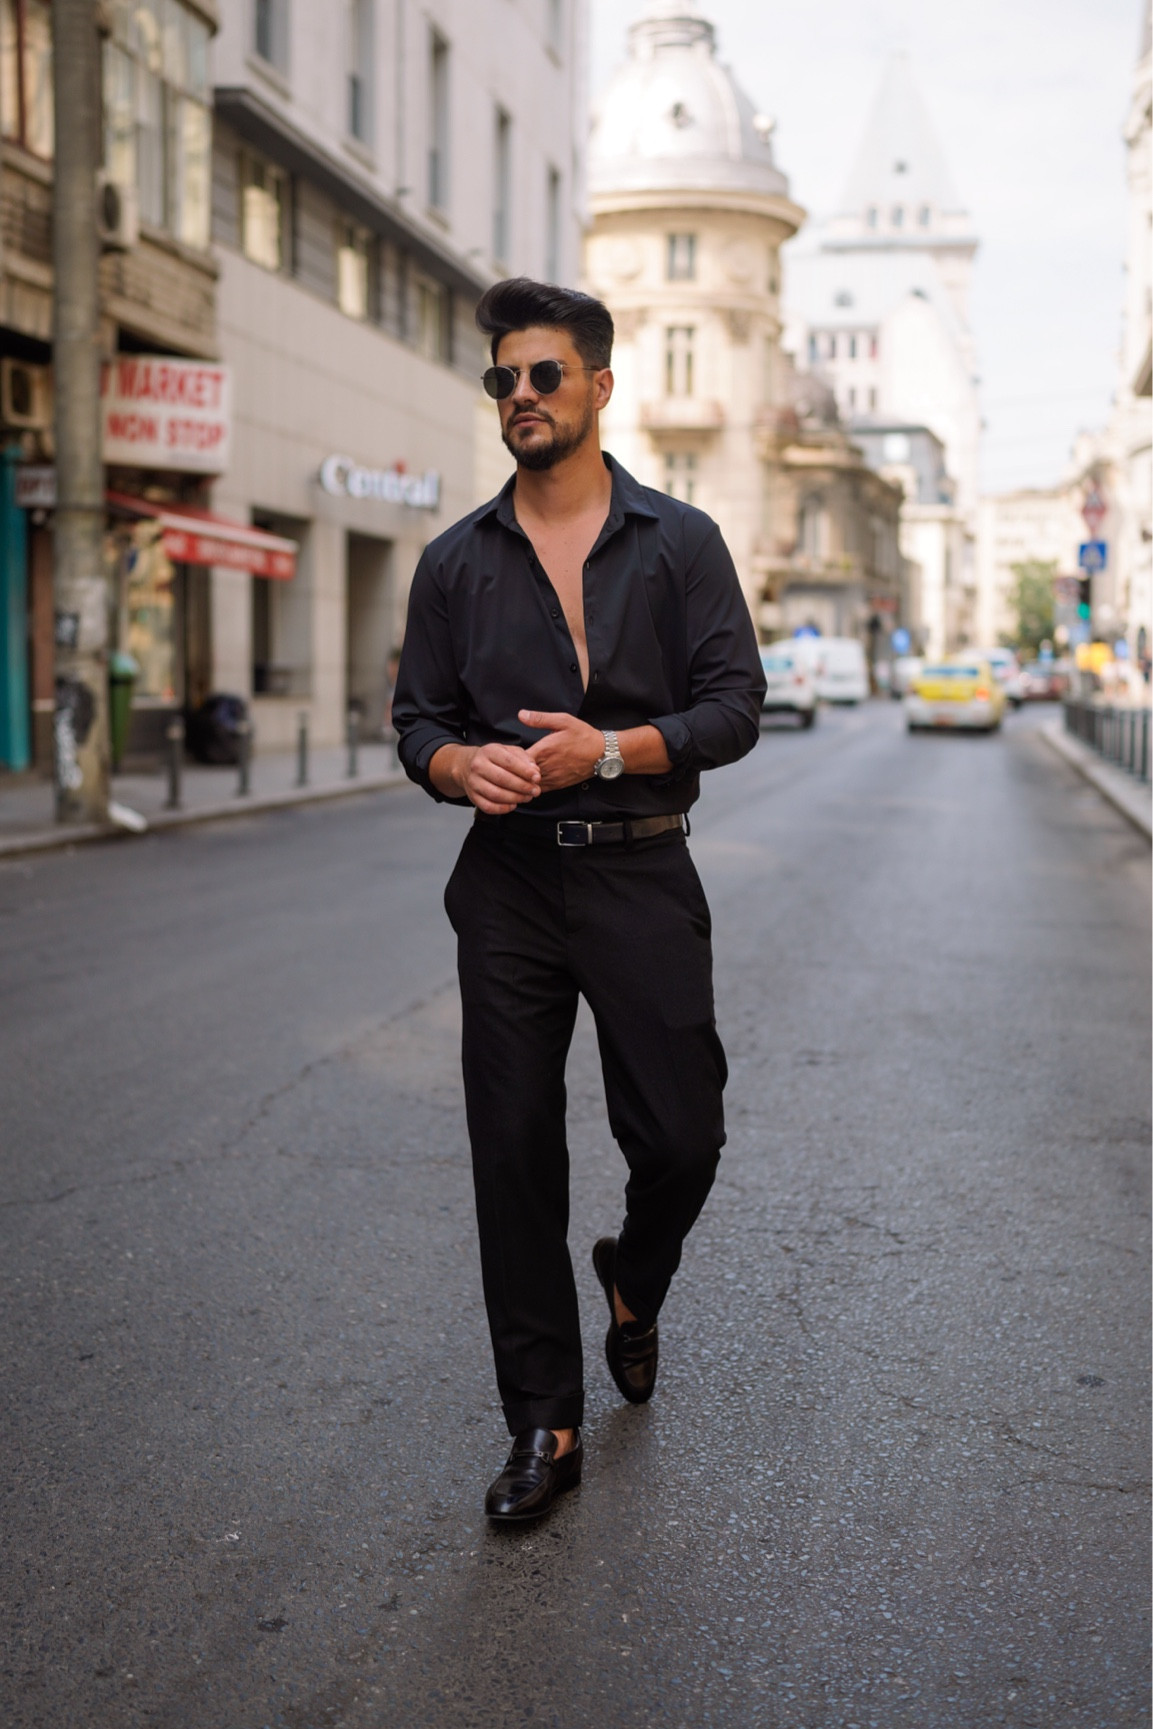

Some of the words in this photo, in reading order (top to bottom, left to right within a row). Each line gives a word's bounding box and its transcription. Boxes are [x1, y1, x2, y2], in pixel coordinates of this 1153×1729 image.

[117, 358, 223, 408] MARKET
[107, 412, 158, 444] NON
[166, 416, 224, 450] STOP
